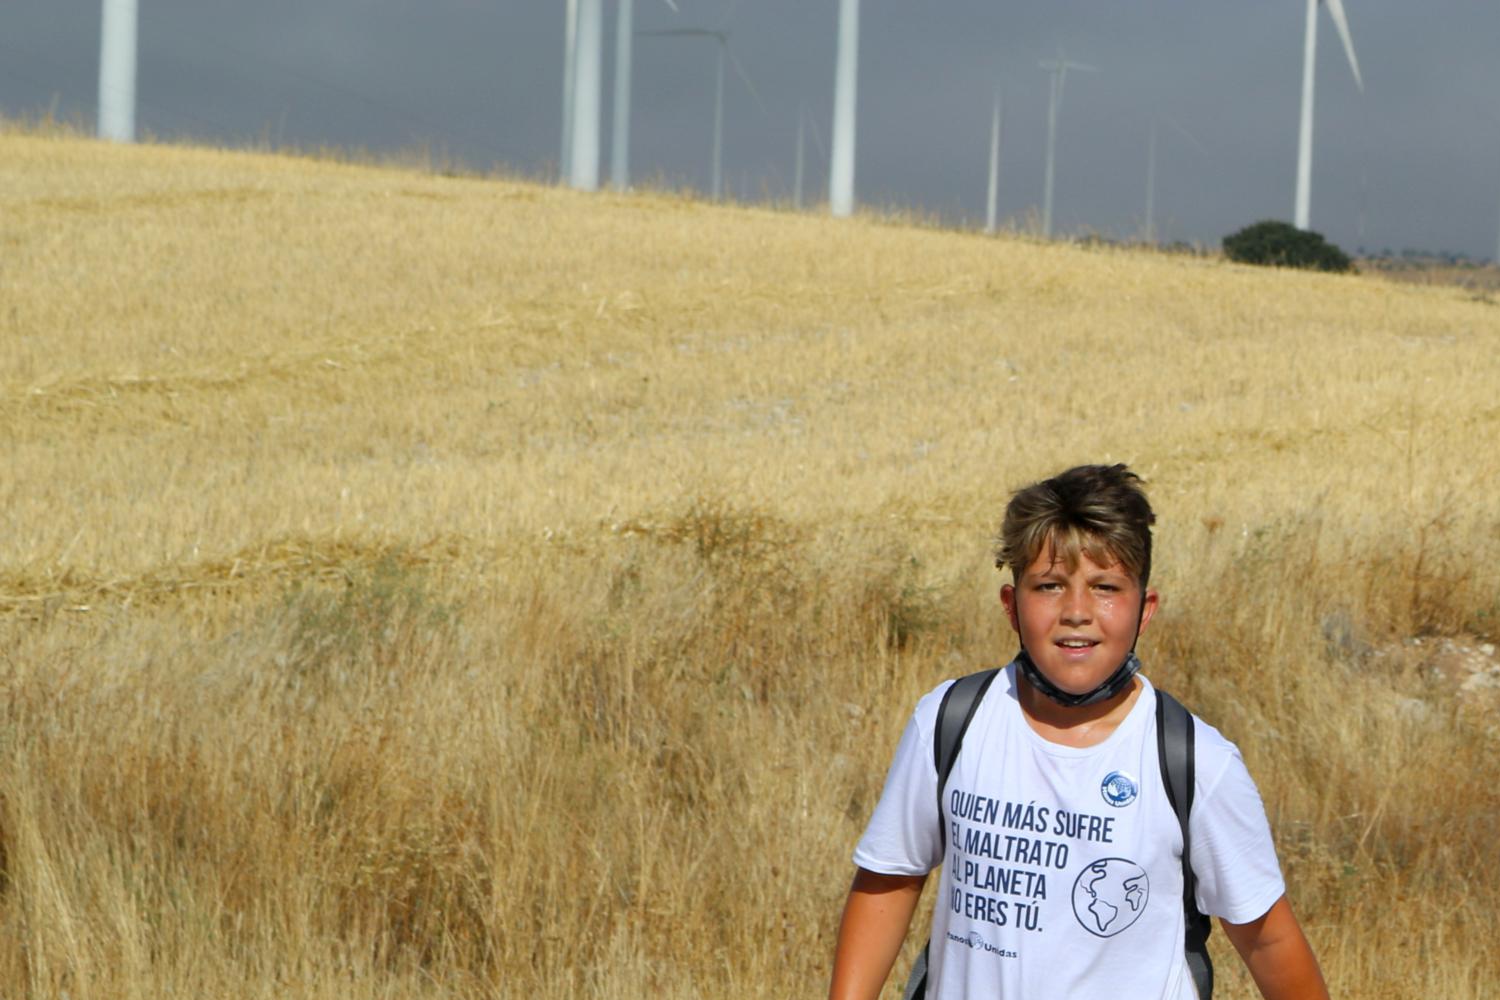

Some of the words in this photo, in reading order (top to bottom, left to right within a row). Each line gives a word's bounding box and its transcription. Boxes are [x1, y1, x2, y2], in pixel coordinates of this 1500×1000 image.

[951, 789, 1000, 825] QUIEN
[1002, 801, 1050, 833] MÁS
[1053, 809, 1115, 843] SUFRE
[952, 822, 961, 850] EL
[964, 827, 1069, 870] MALTRATO
[952, 853, 962, 882] AL
[964, 860, 1047, 900] PLANETA
[965, 892, 1008, 927] ERES
[1014, 901, 1043, 933] TÚ.
[984, 943, 1017, 959] Unidas
